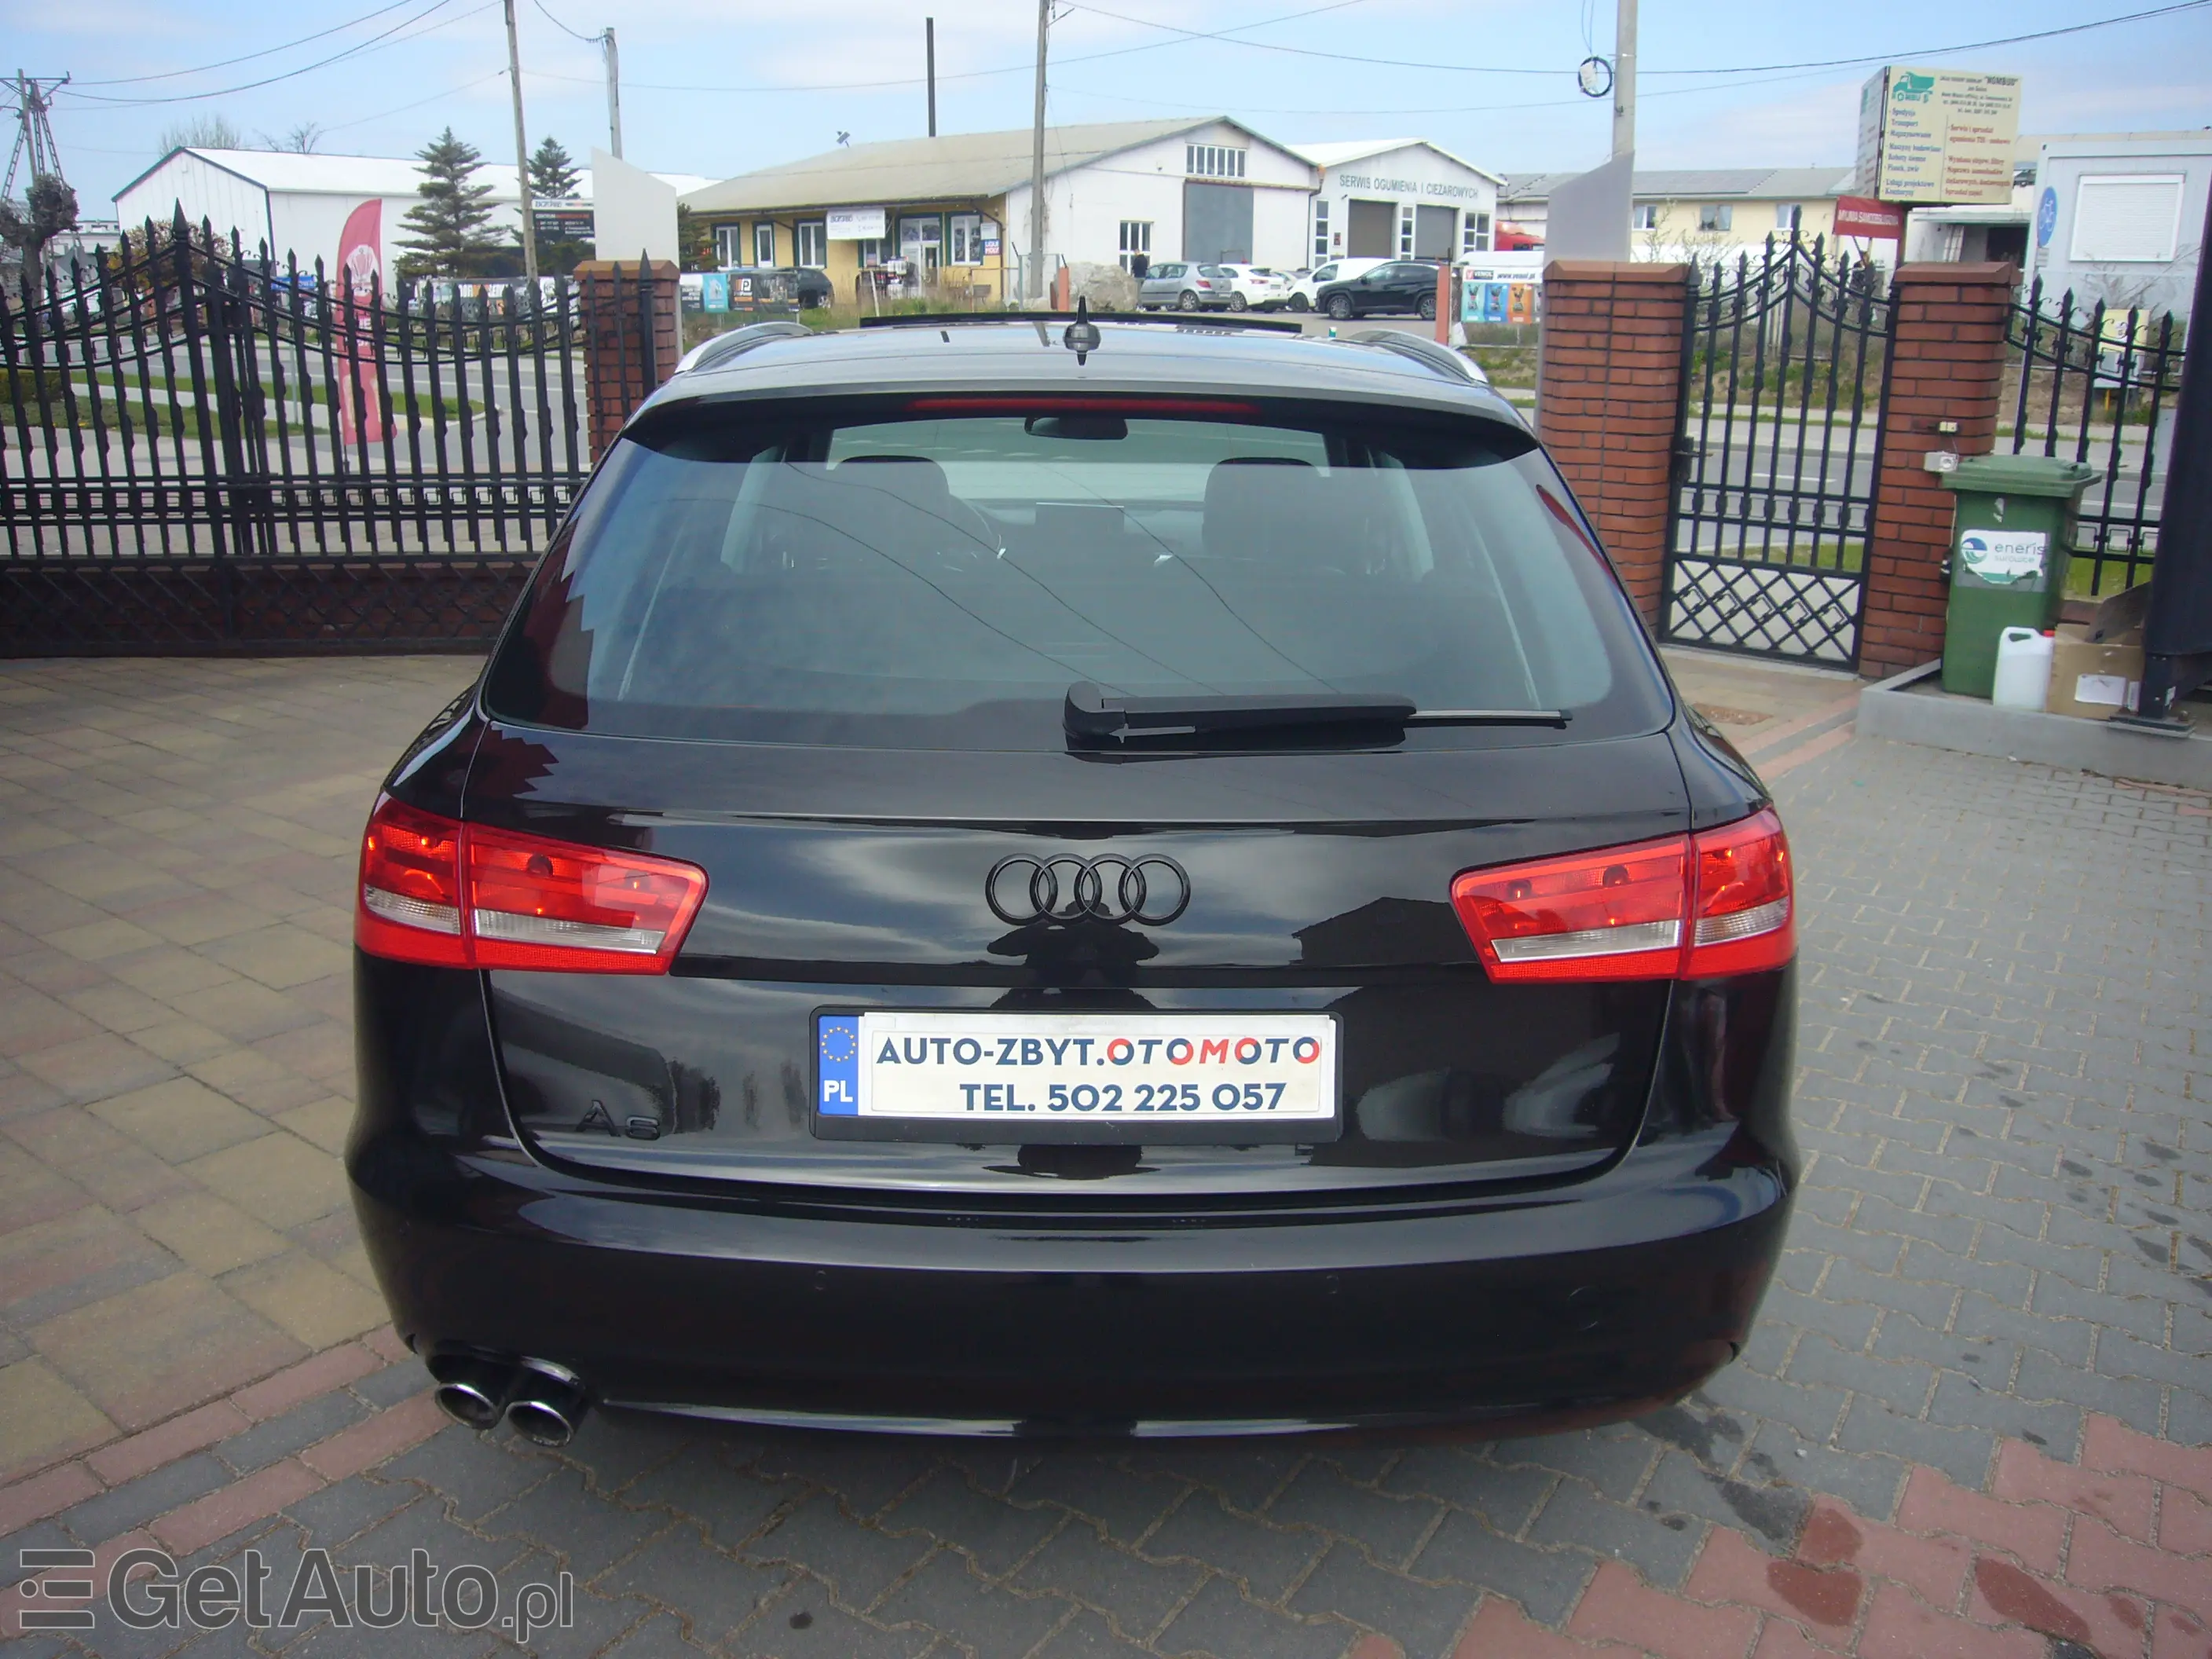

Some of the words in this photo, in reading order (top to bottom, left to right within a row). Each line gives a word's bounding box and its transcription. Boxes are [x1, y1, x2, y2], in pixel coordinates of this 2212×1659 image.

[1339, 174, 1371, 189] SERWIS
[1374, 178, 1418, 193] OGUMIENIA
[876, 1036, 1320, 1066] AUTO-ZBYT.OTOMOTO
[824, 1079, 853, 1103] PL
[960, 1084, 1035, 1111] TEL.
[1047, 1084, 1122, 1111] 502
[1133, 1084, 1200, 1111] 225
[1212, 1082, 1287, 1111] 057
[575, 1100, 661, 1141] A6
